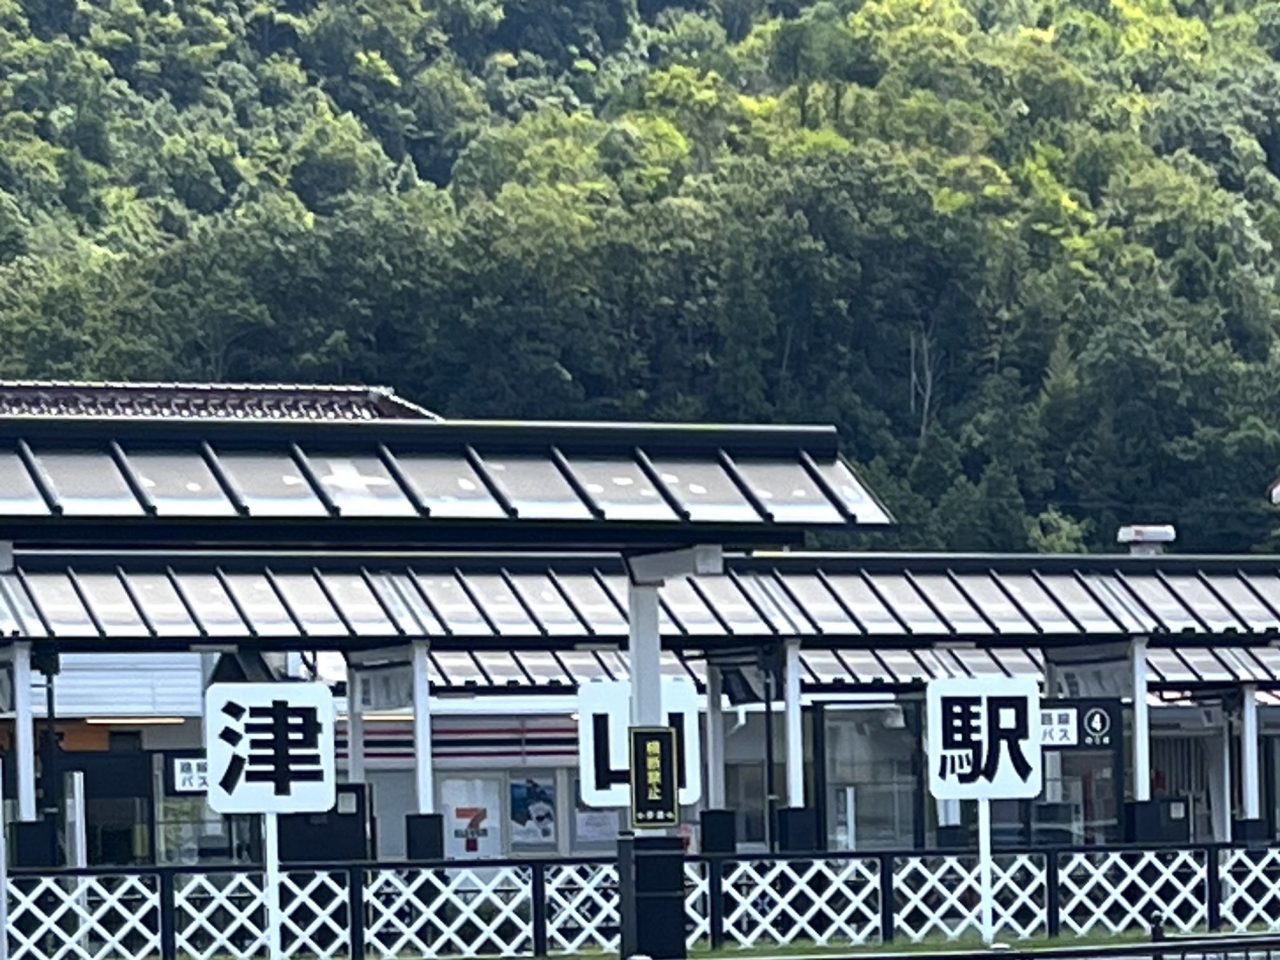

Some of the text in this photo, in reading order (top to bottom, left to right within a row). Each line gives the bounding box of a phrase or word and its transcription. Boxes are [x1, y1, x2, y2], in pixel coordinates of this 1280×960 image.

[219, 700, 324, 796] 津
[938, 696, 1033, 783] 駅
[1091, 713, 1102, 731] 4
